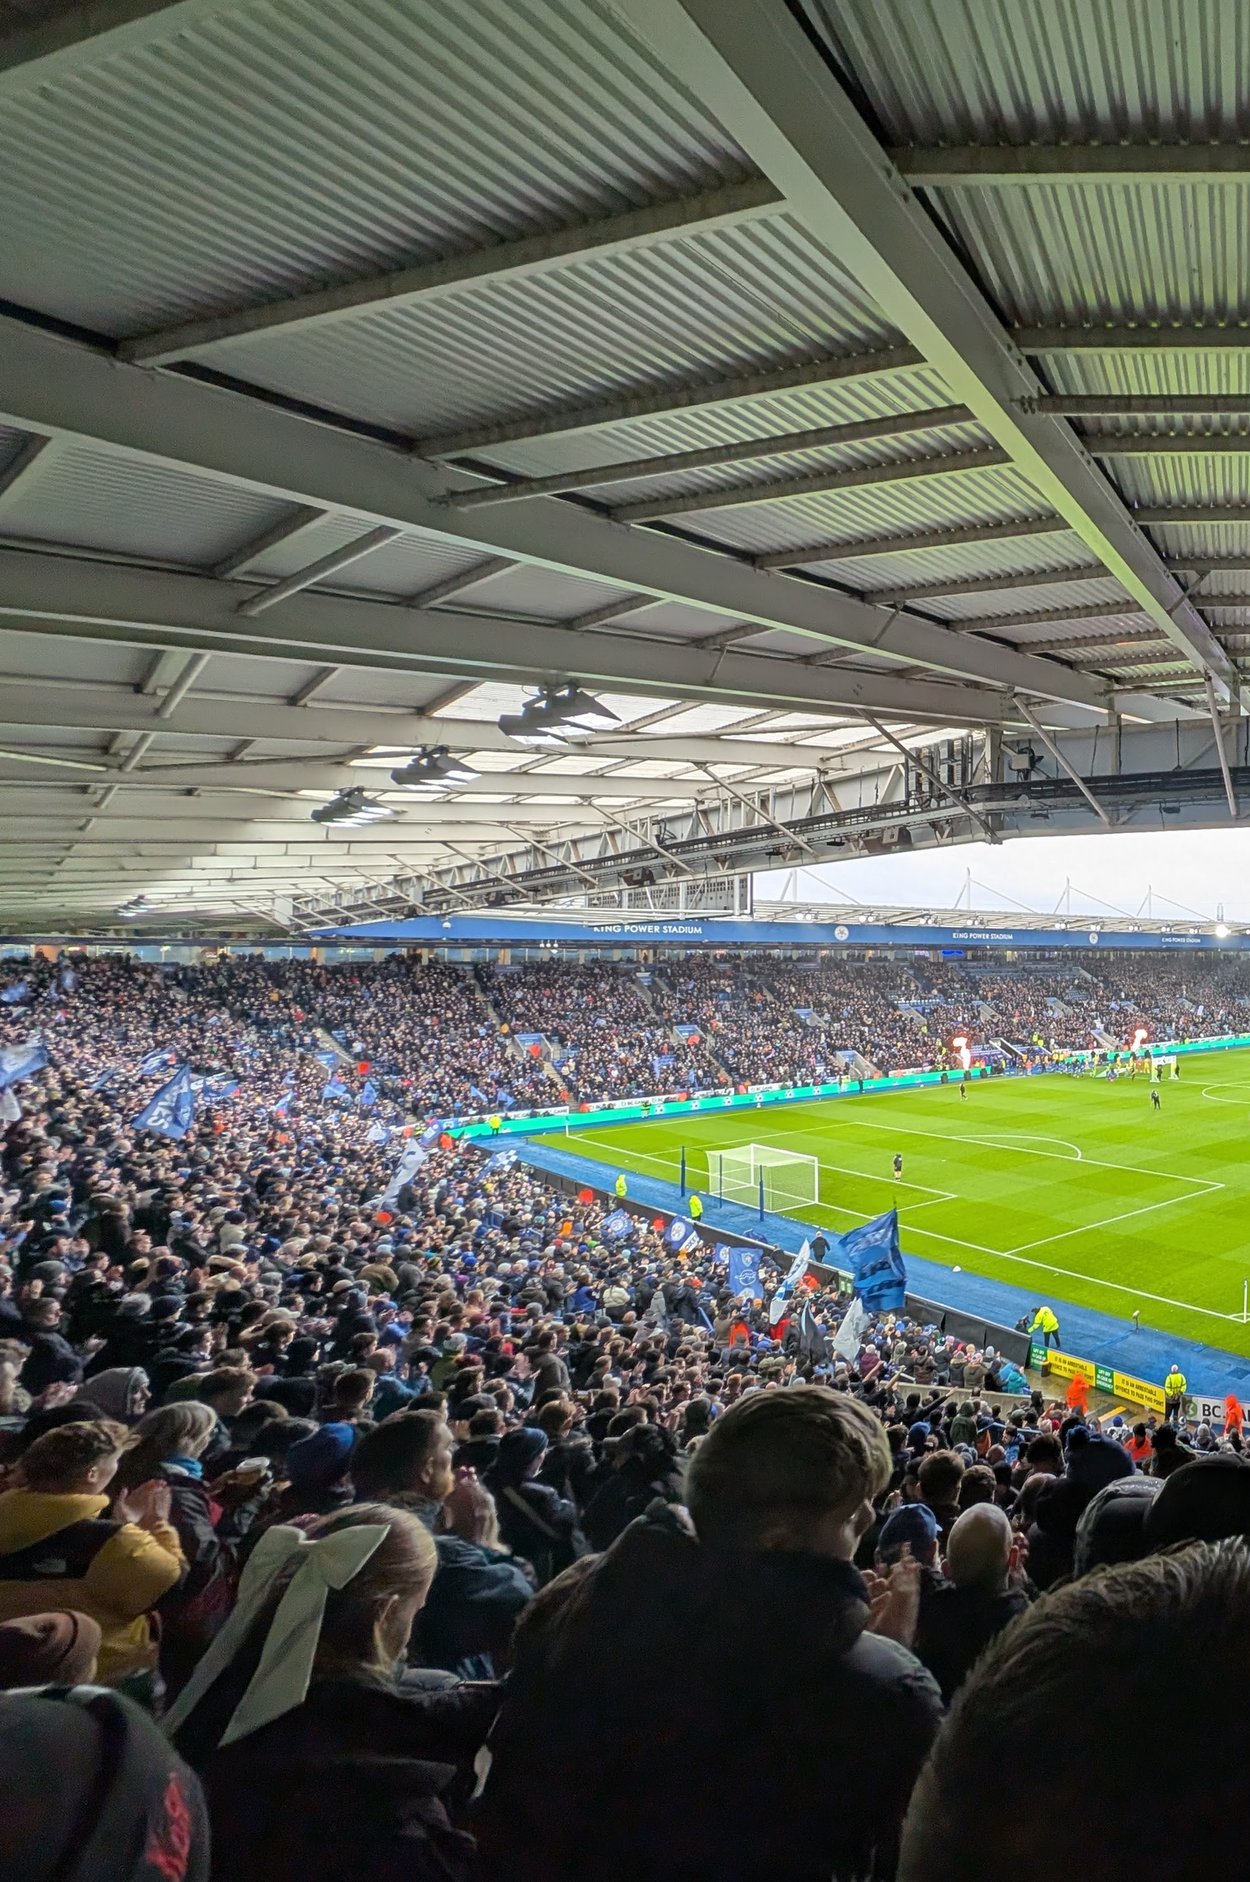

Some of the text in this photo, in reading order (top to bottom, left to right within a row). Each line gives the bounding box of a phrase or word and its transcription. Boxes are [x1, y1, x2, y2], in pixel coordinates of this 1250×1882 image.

[593, 925, 702, 934] KING POWER STADIUM
